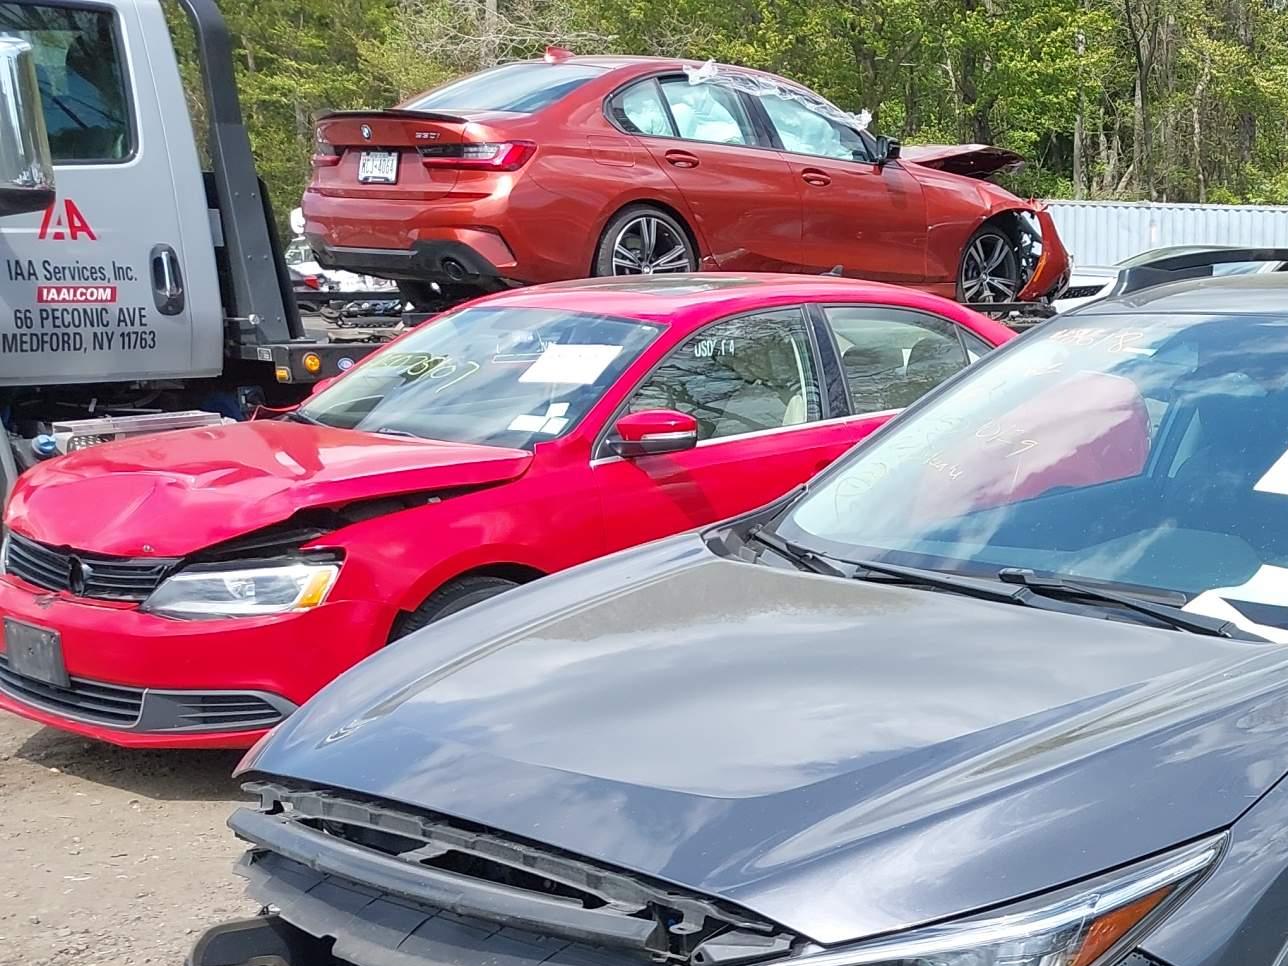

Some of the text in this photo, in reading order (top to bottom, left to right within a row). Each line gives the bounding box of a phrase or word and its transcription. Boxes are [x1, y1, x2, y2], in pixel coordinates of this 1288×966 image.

[7, 260, 138, 283] IAA Services, Inc.
[42, 287, 112, 301] IAAI.COM
[14, 306, 148, 329] 66 PECONIC AVE
[2, 330, 156, 354] MEDFORD, NY 11763
